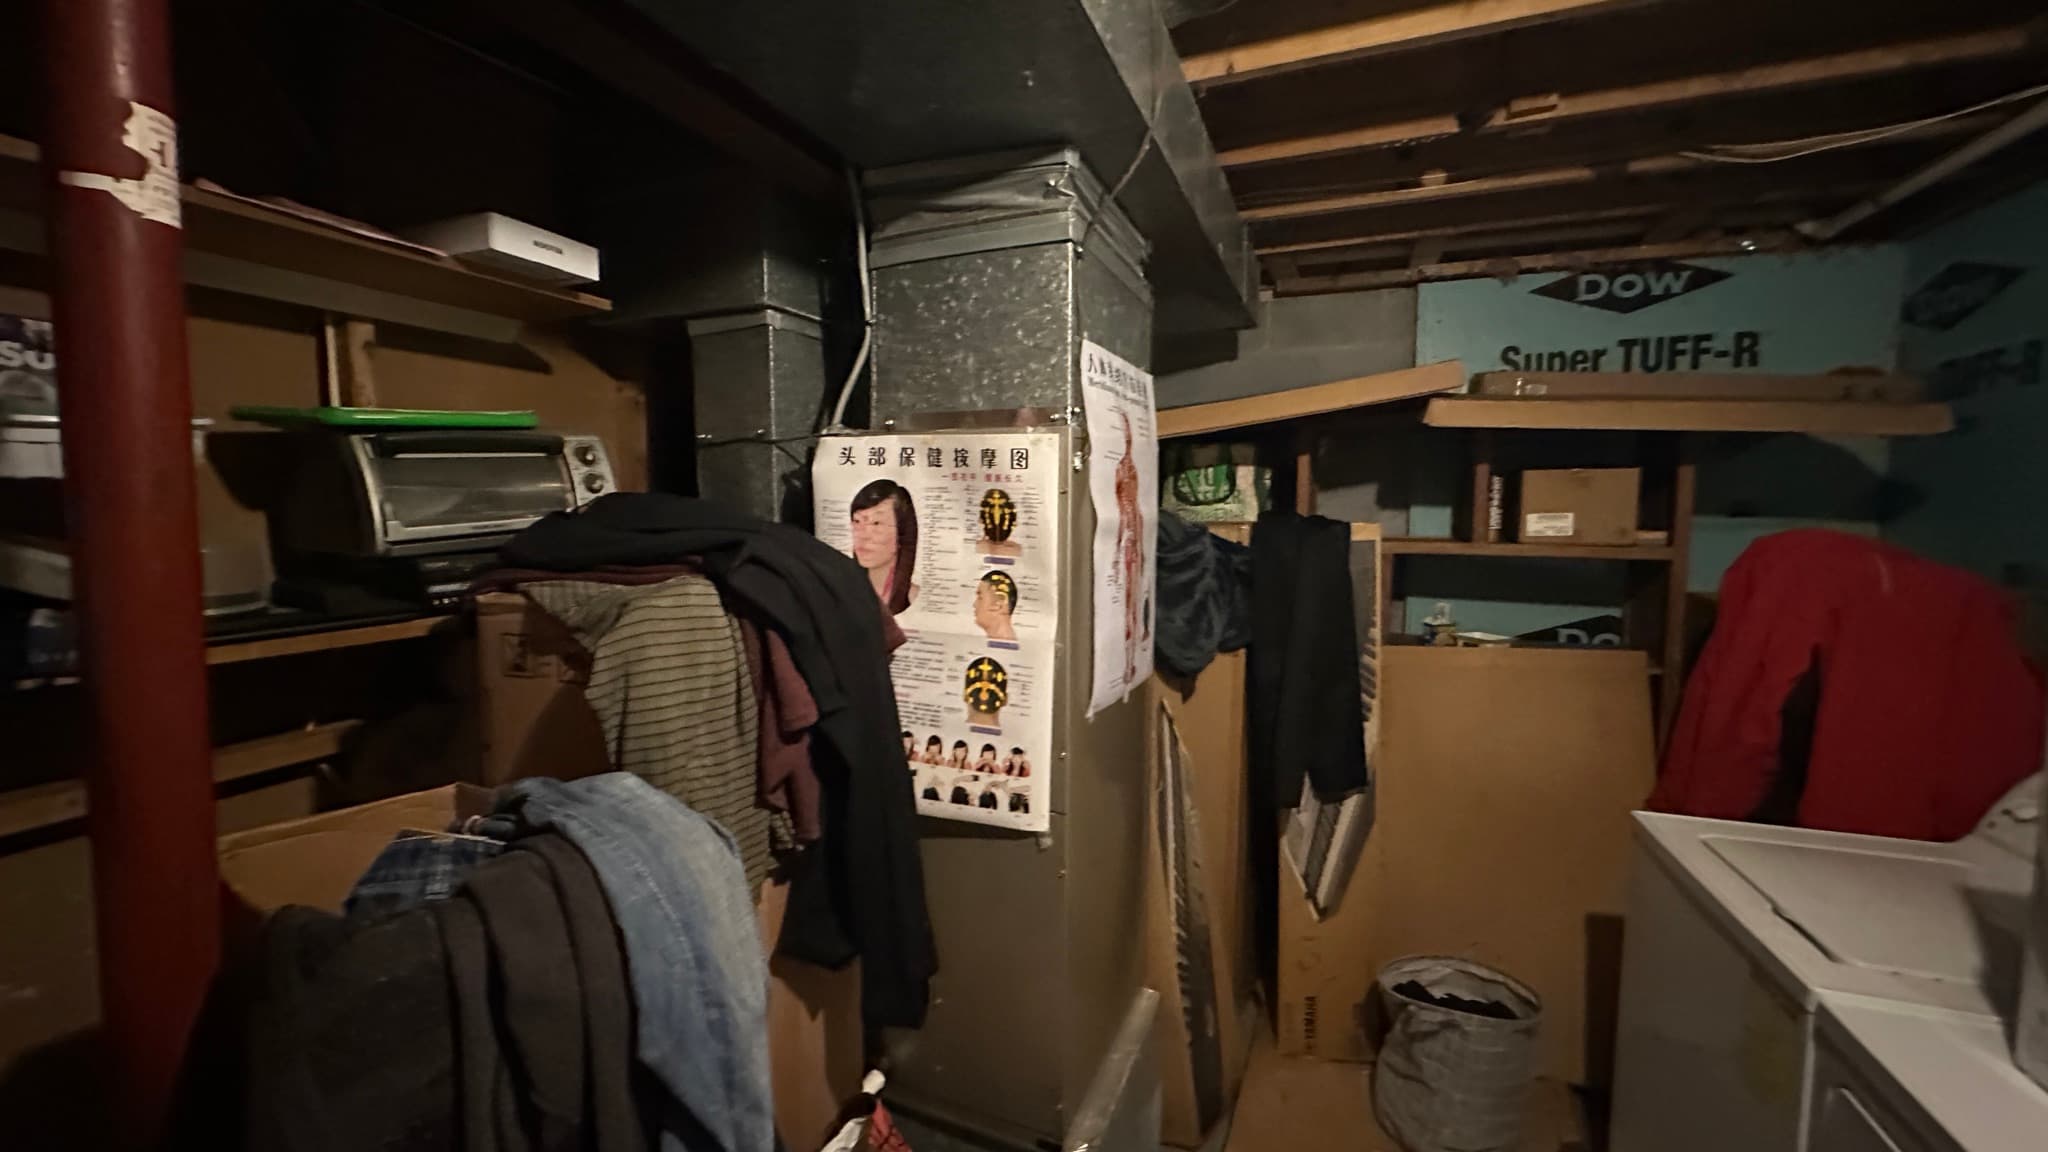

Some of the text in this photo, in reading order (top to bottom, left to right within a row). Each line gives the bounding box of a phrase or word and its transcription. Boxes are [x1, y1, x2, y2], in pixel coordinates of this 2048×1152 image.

[1572, 270, 1693, 301] DOW
[1616, 331, 1759, 374] TUFF-R
[839, 446, 1029, 470] 头部保健按摩图
[1557, 628, 1620, 645] DO
